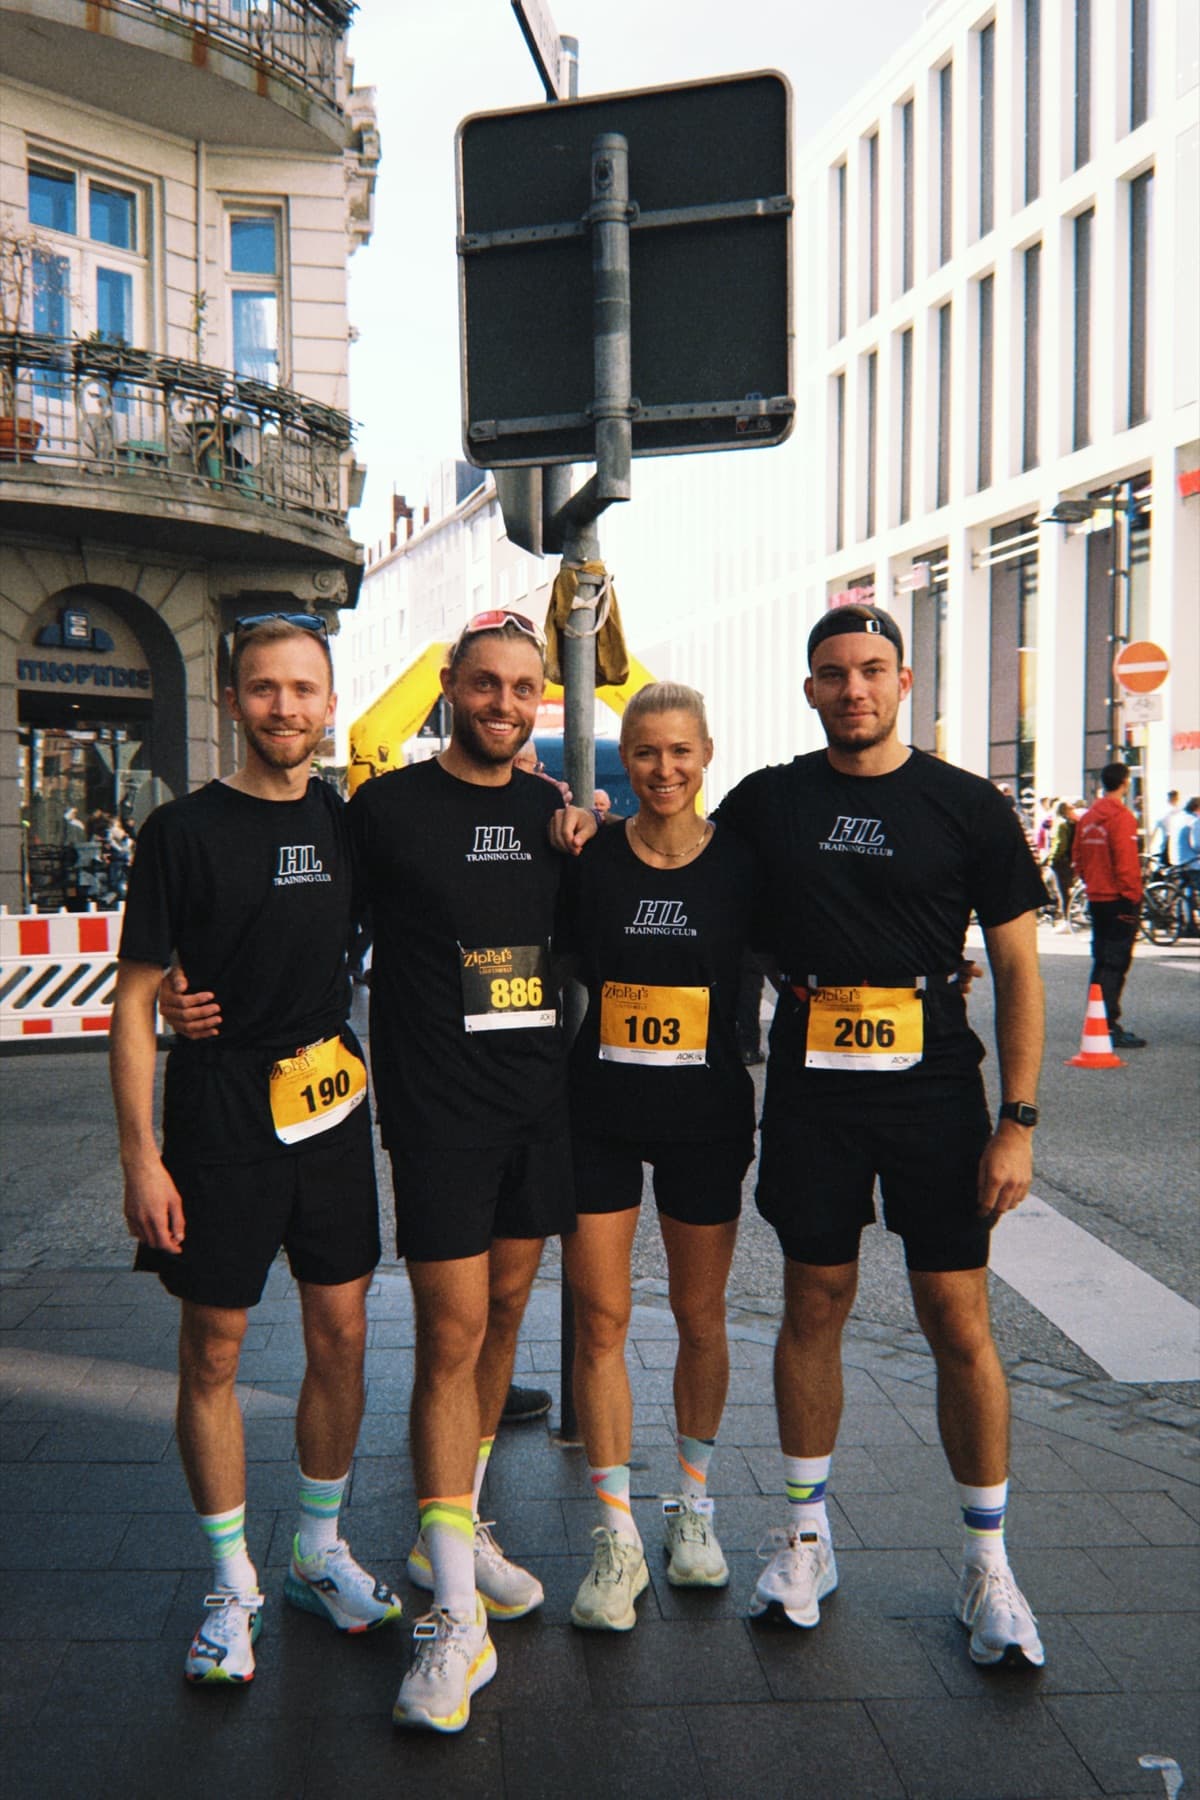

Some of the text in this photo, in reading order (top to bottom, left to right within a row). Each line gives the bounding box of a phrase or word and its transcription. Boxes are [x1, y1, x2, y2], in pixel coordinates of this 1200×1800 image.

[473, 826, 521, 852] HL
[828, 815, 886, 846] HL
[278, 845, 323, 875] HL
[465, 852, 532, 862] TRAINING CLUB
[818, 841, 894, 857] TRAINING CLUB
[273, 874, 315, 886] TRAINING
[632, 900, 688, 927] HL
[623, 926, 697, 936] TRAINING CLUB
[490, 977, 542, 1008] 886
[625, 1015, 681, 1046] 103
[834, 1018, 895, 1048] 206
[300, 1069, 350, 1113] 190
